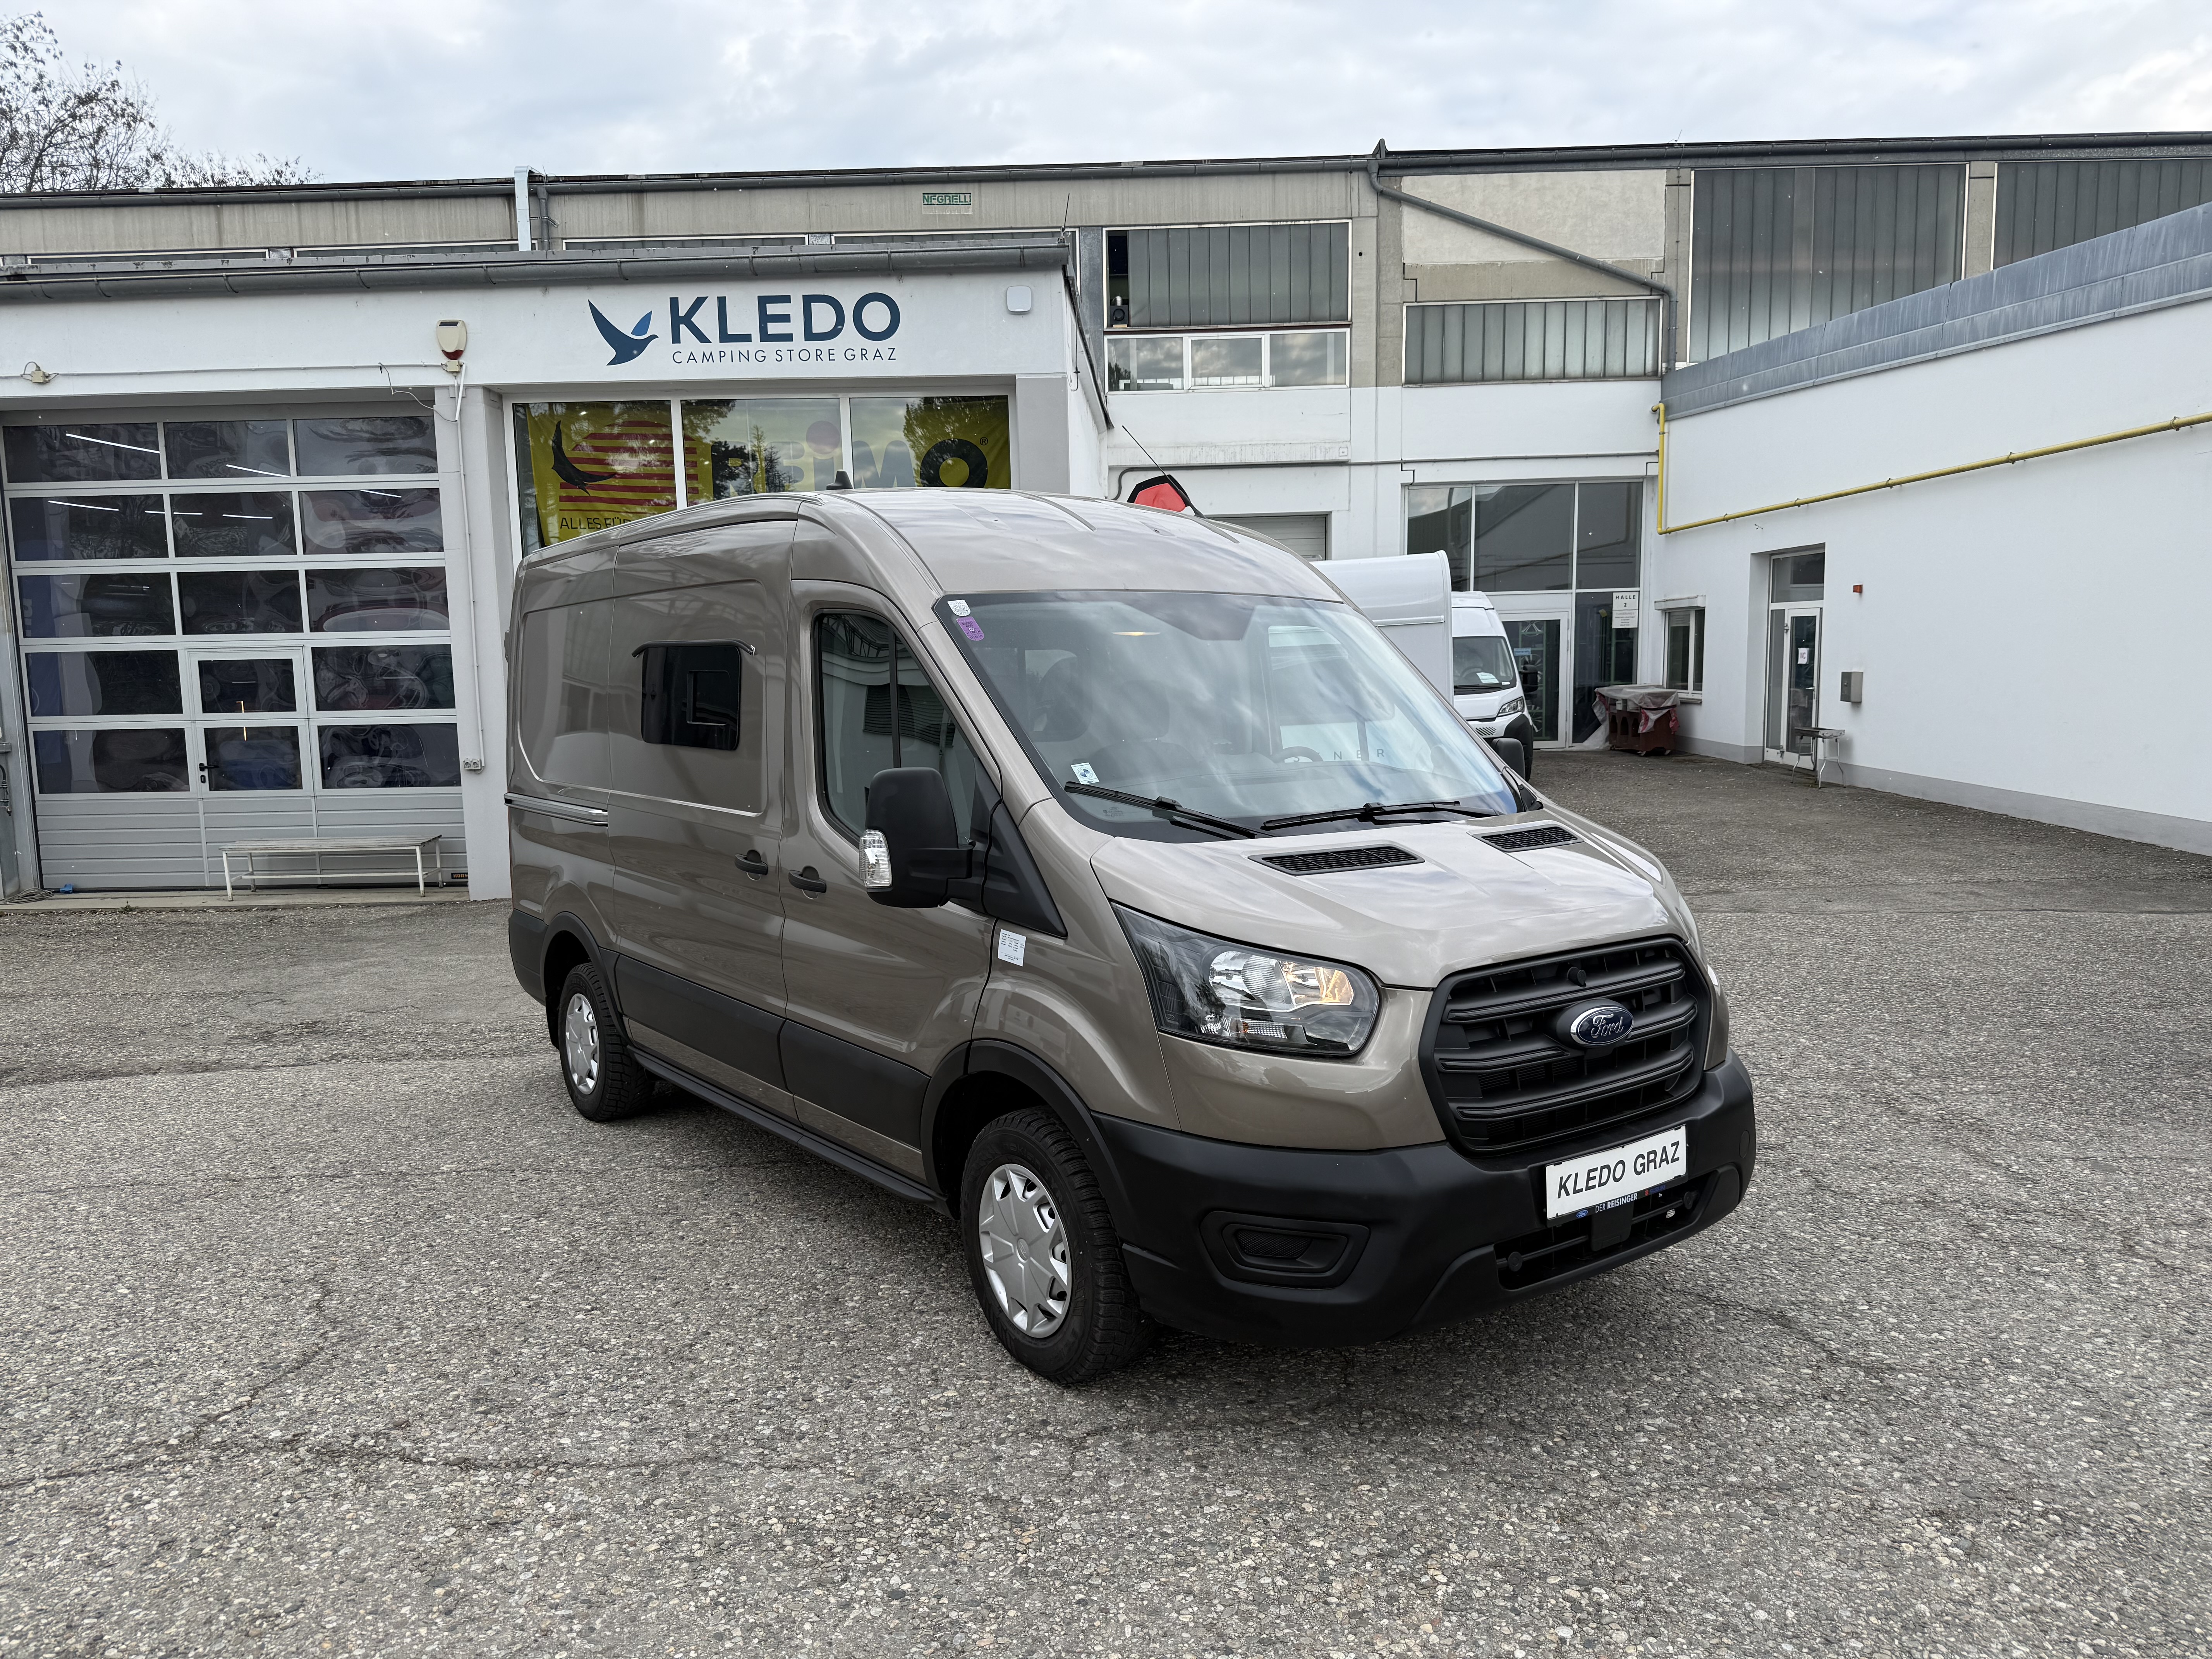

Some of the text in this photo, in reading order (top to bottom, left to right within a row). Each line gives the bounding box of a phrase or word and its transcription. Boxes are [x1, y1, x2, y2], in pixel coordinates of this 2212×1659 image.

[669, 292, 900, 344] KLEDO
[672, 348, 896, 364] CAMPING STORE GRAZ
[560, 517, 602, 530] ALLES
[1591, 1013, 1624, 1039] Ford
[1558, 1140, 1680, 1199] KLEDO GRAZ
[1595, 1203, 1606, 1213] DER
[1607, 1193, 1638, 1209] REISINGER
